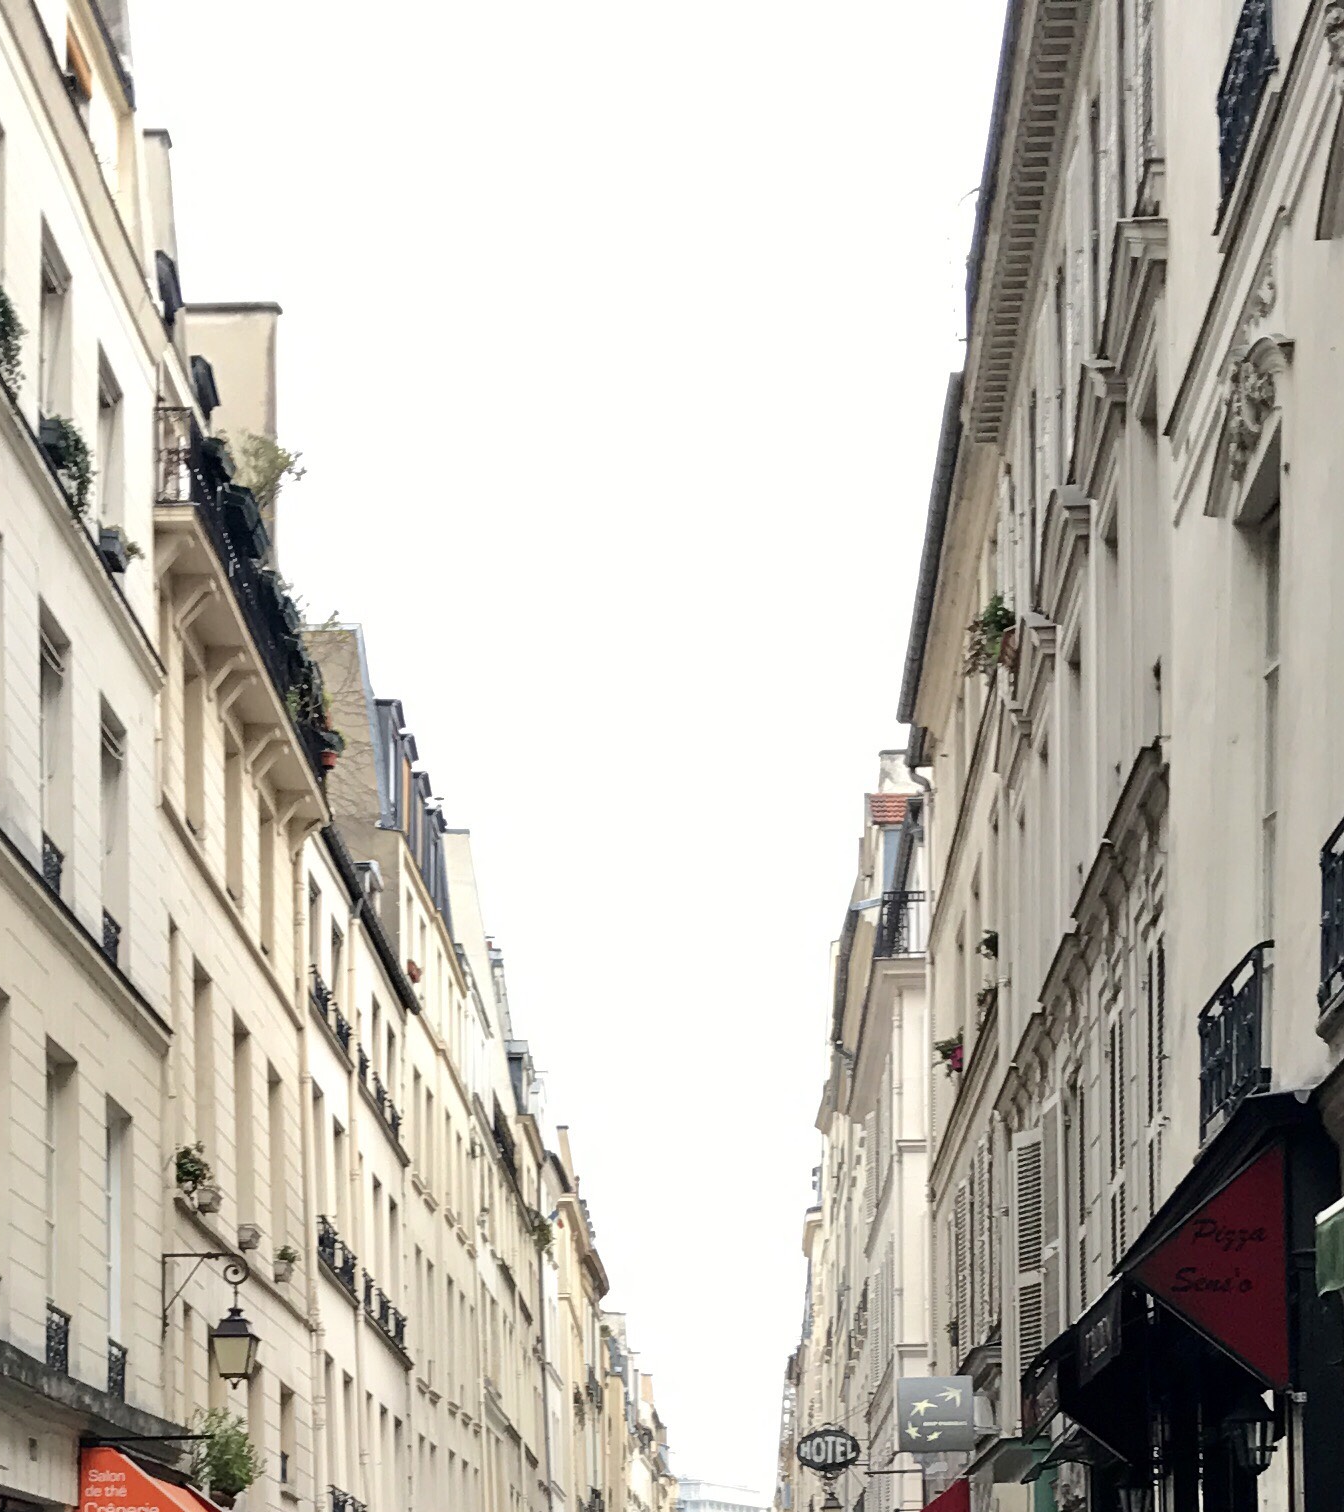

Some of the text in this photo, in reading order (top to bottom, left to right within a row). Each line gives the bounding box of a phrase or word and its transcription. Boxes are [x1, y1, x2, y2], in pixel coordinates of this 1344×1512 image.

[799, 1436, 857, 1464] HOTEL
[88, 1470, 126, 1482] Salon
[85, 1485, 128, 1498] de thé
